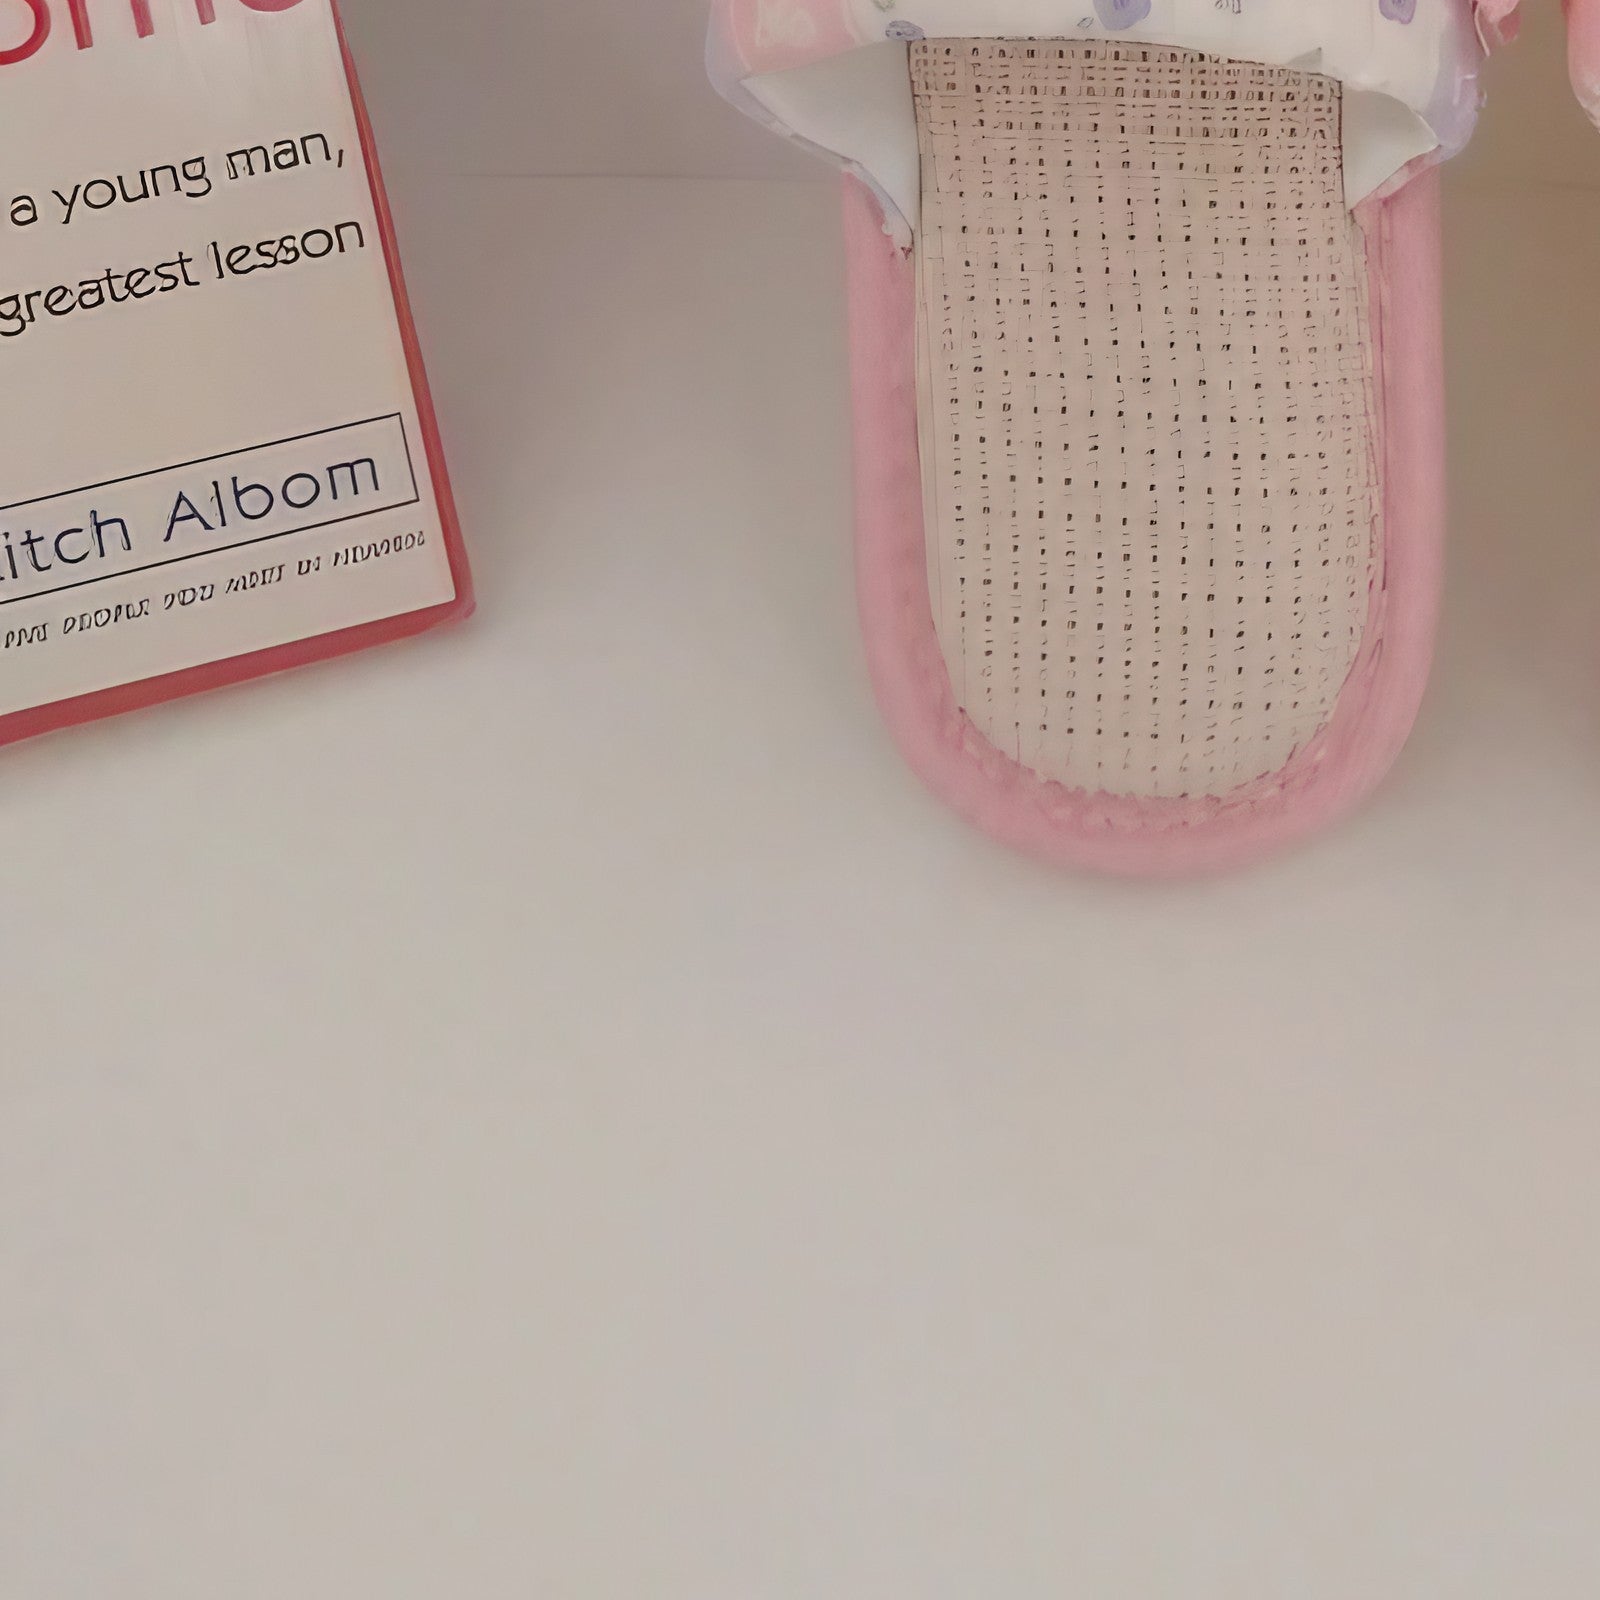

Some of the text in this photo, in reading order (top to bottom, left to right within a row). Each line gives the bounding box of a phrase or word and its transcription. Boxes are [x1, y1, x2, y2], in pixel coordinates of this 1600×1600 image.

[10, 132, 345, 227] a young man,
[0, 220, 365, 338] greatest lesson
[0, 456, 381, 582] itch Albom
